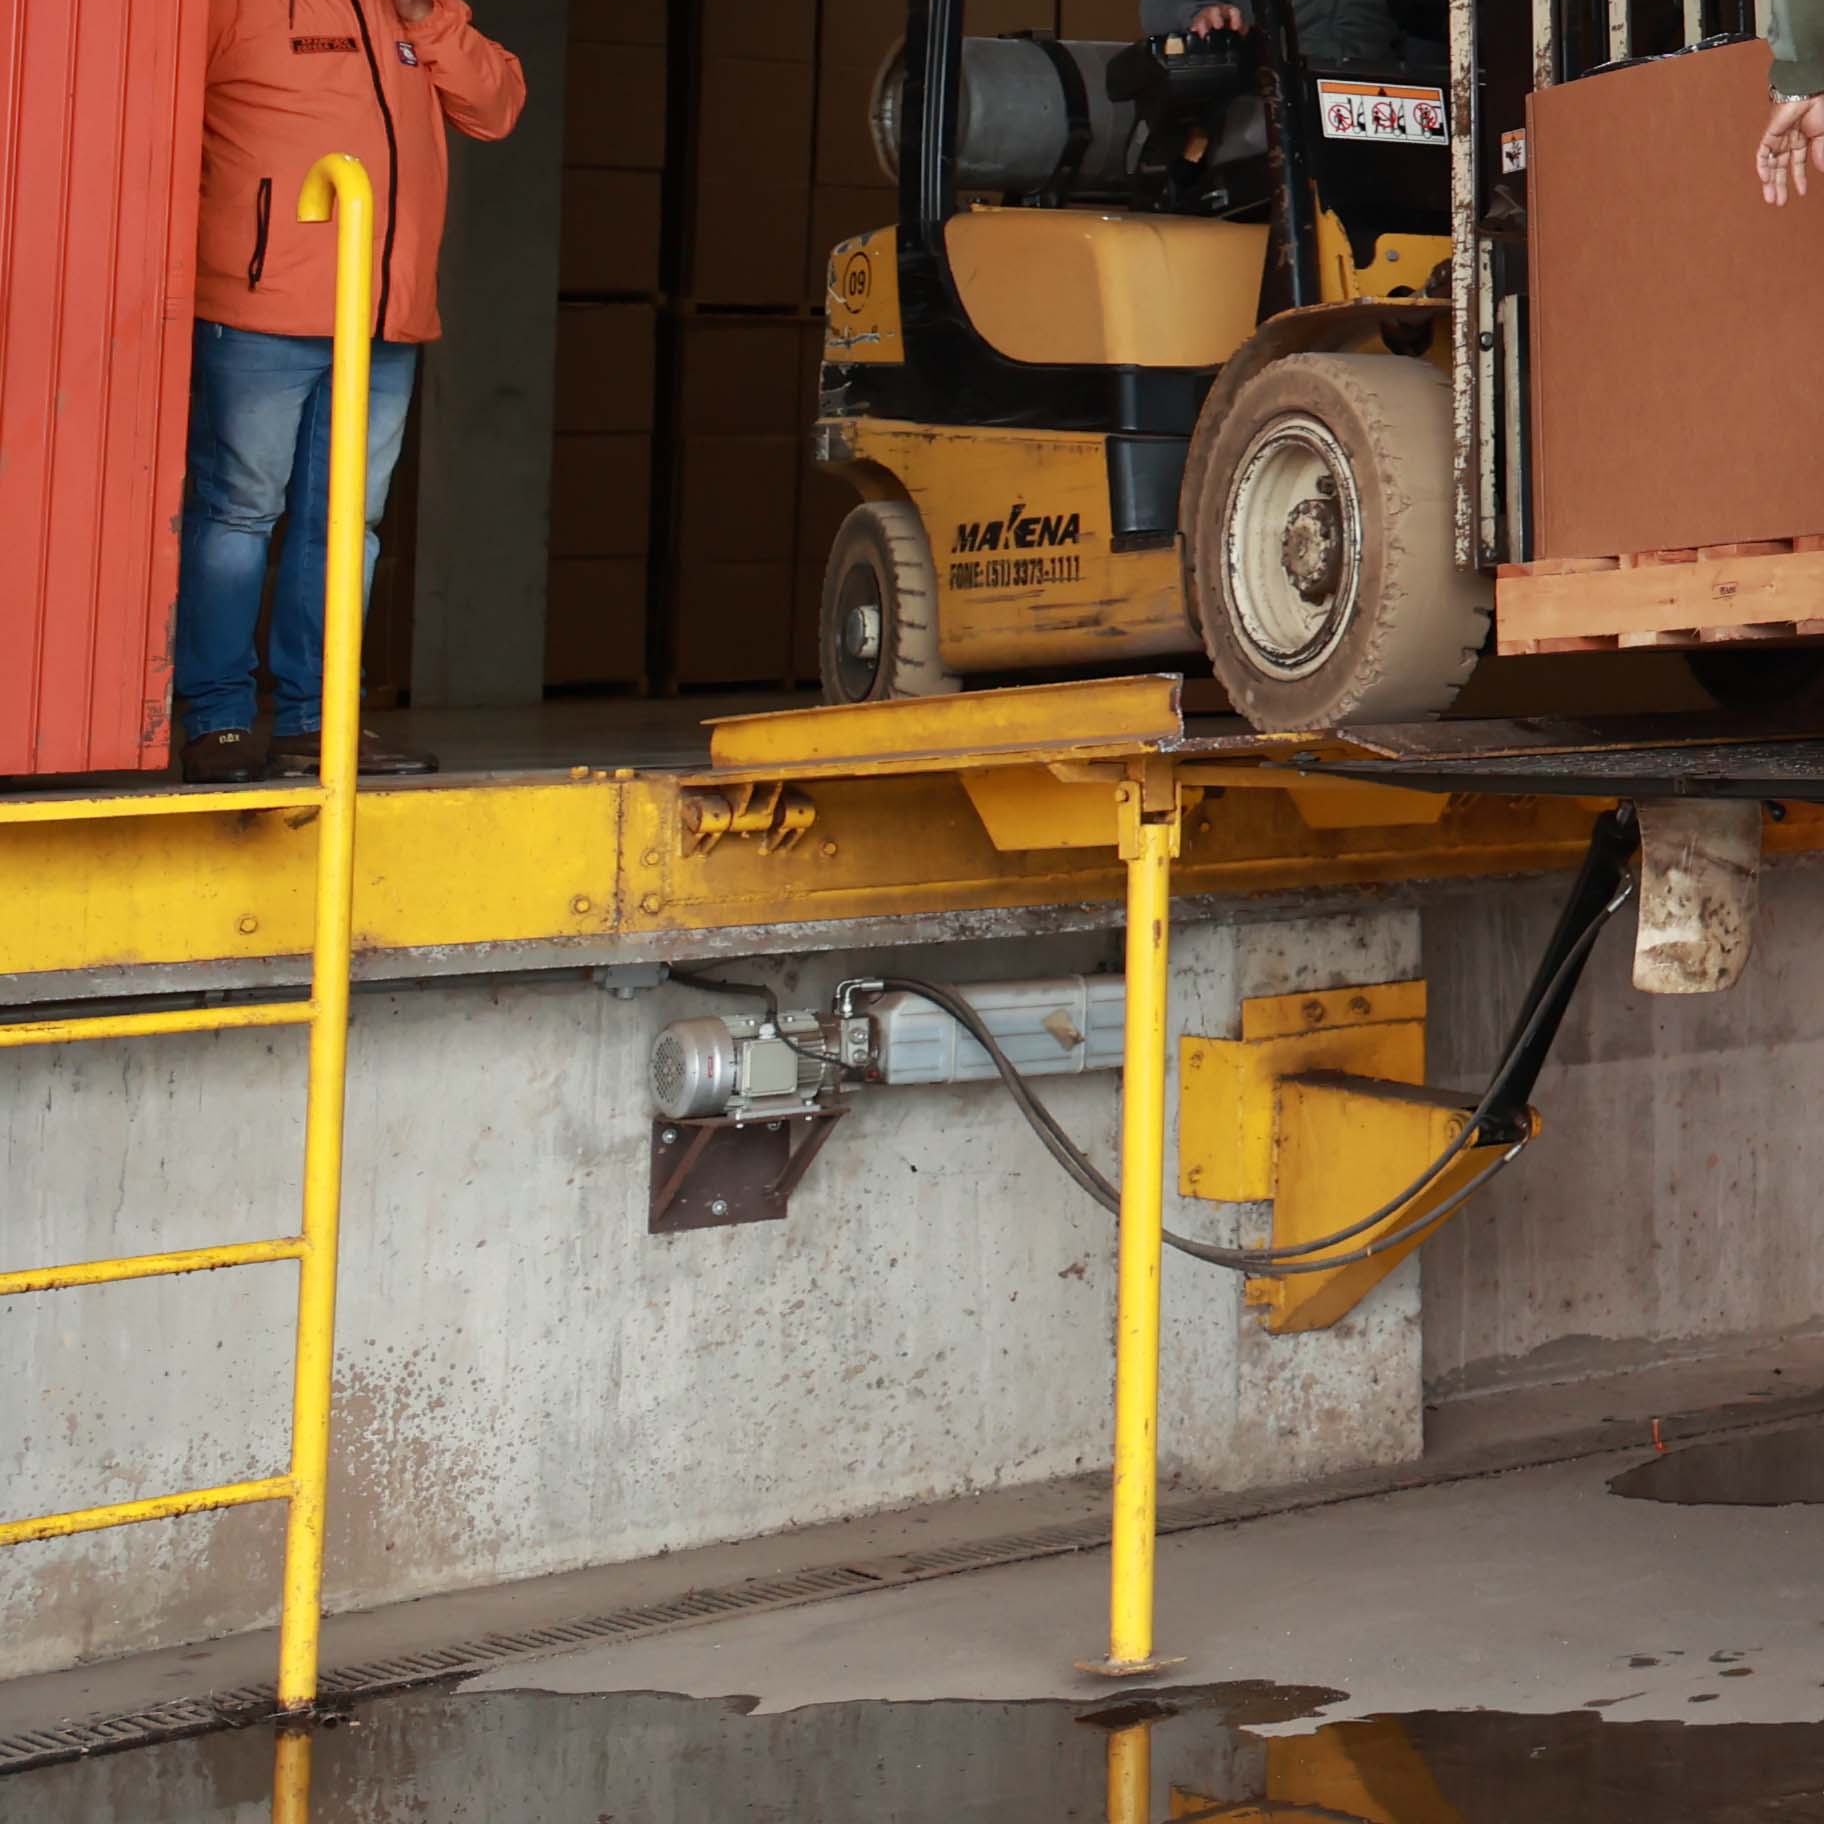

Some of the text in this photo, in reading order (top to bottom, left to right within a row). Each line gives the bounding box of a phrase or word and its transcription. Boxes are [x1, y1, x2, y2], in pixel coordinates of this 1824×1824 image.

[849, 270, 866, 296] 09
[951, 503, 1081, 554] MAKENA
[950, 555, 1081, 591] FONE: (51) 3373-1111
